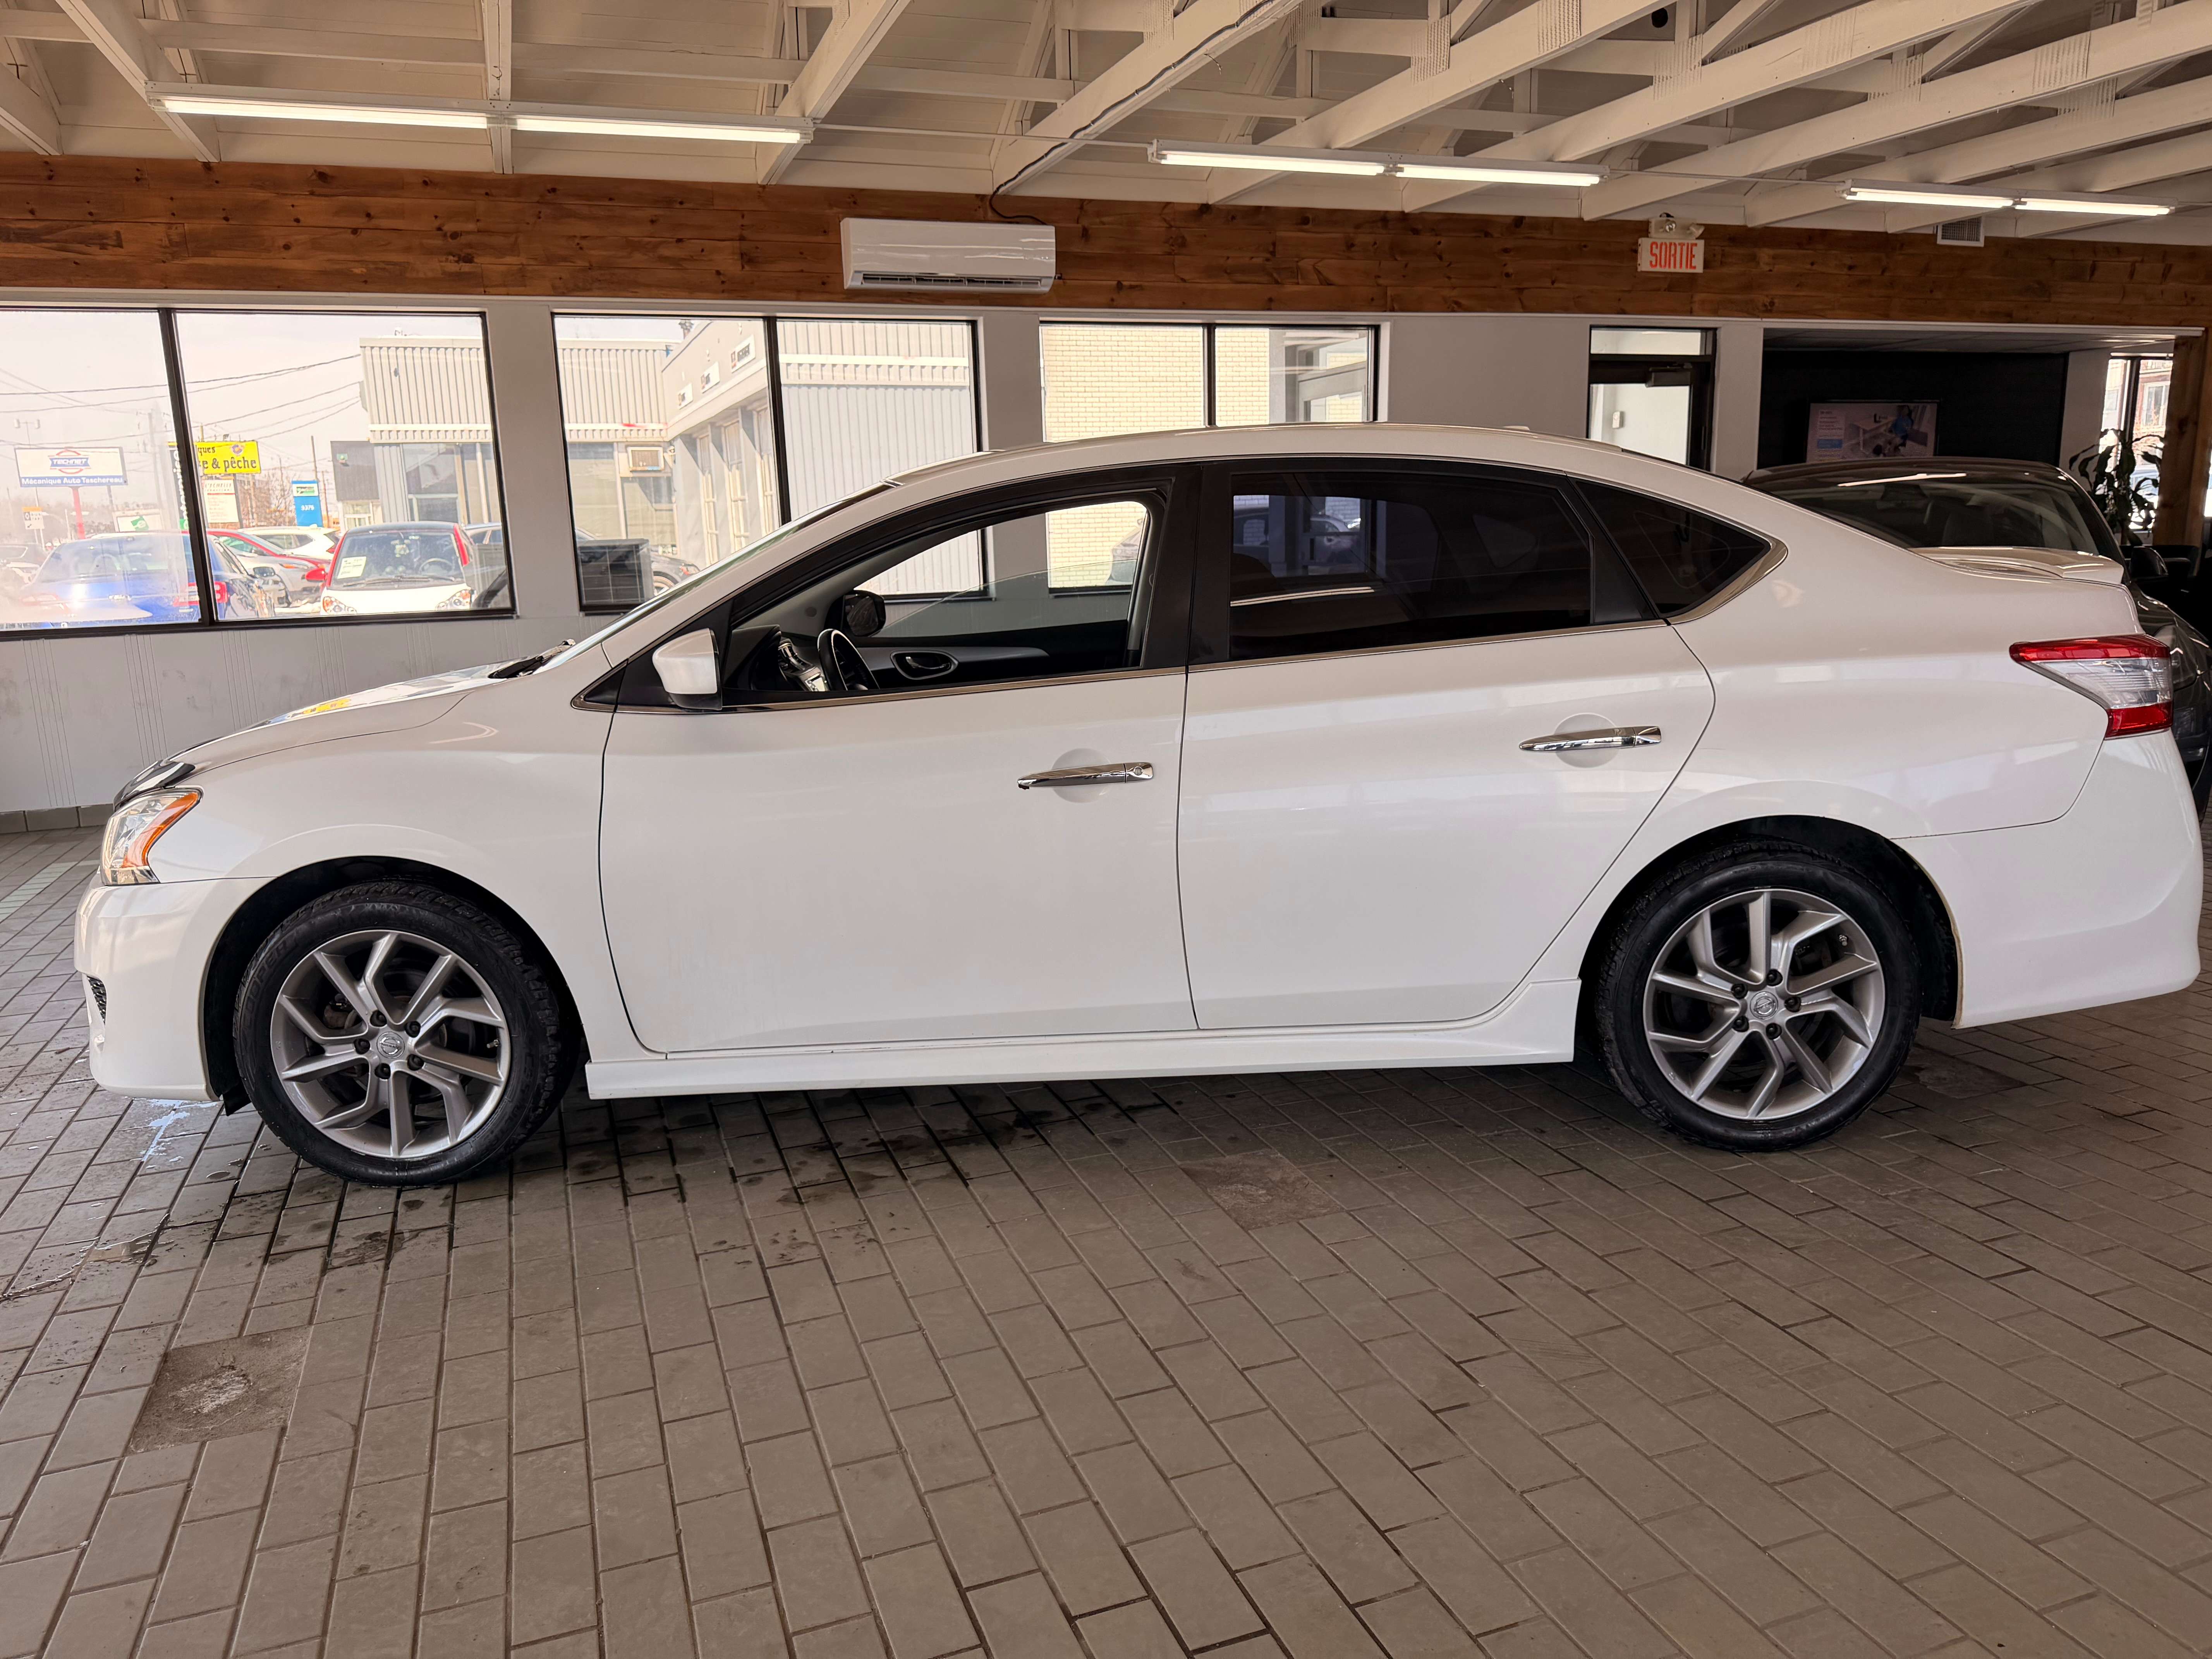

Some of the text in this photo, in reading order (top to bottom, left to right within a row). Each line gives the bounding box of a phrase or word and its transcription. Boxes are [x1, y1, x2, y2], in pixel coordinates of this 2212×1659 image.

[1649, 241, 1698, 270] SORTIE
[211, 458, 220, 469] &
[223, 457, 256, 472] pêche
[242, 939, 287, 1029] COOPER
